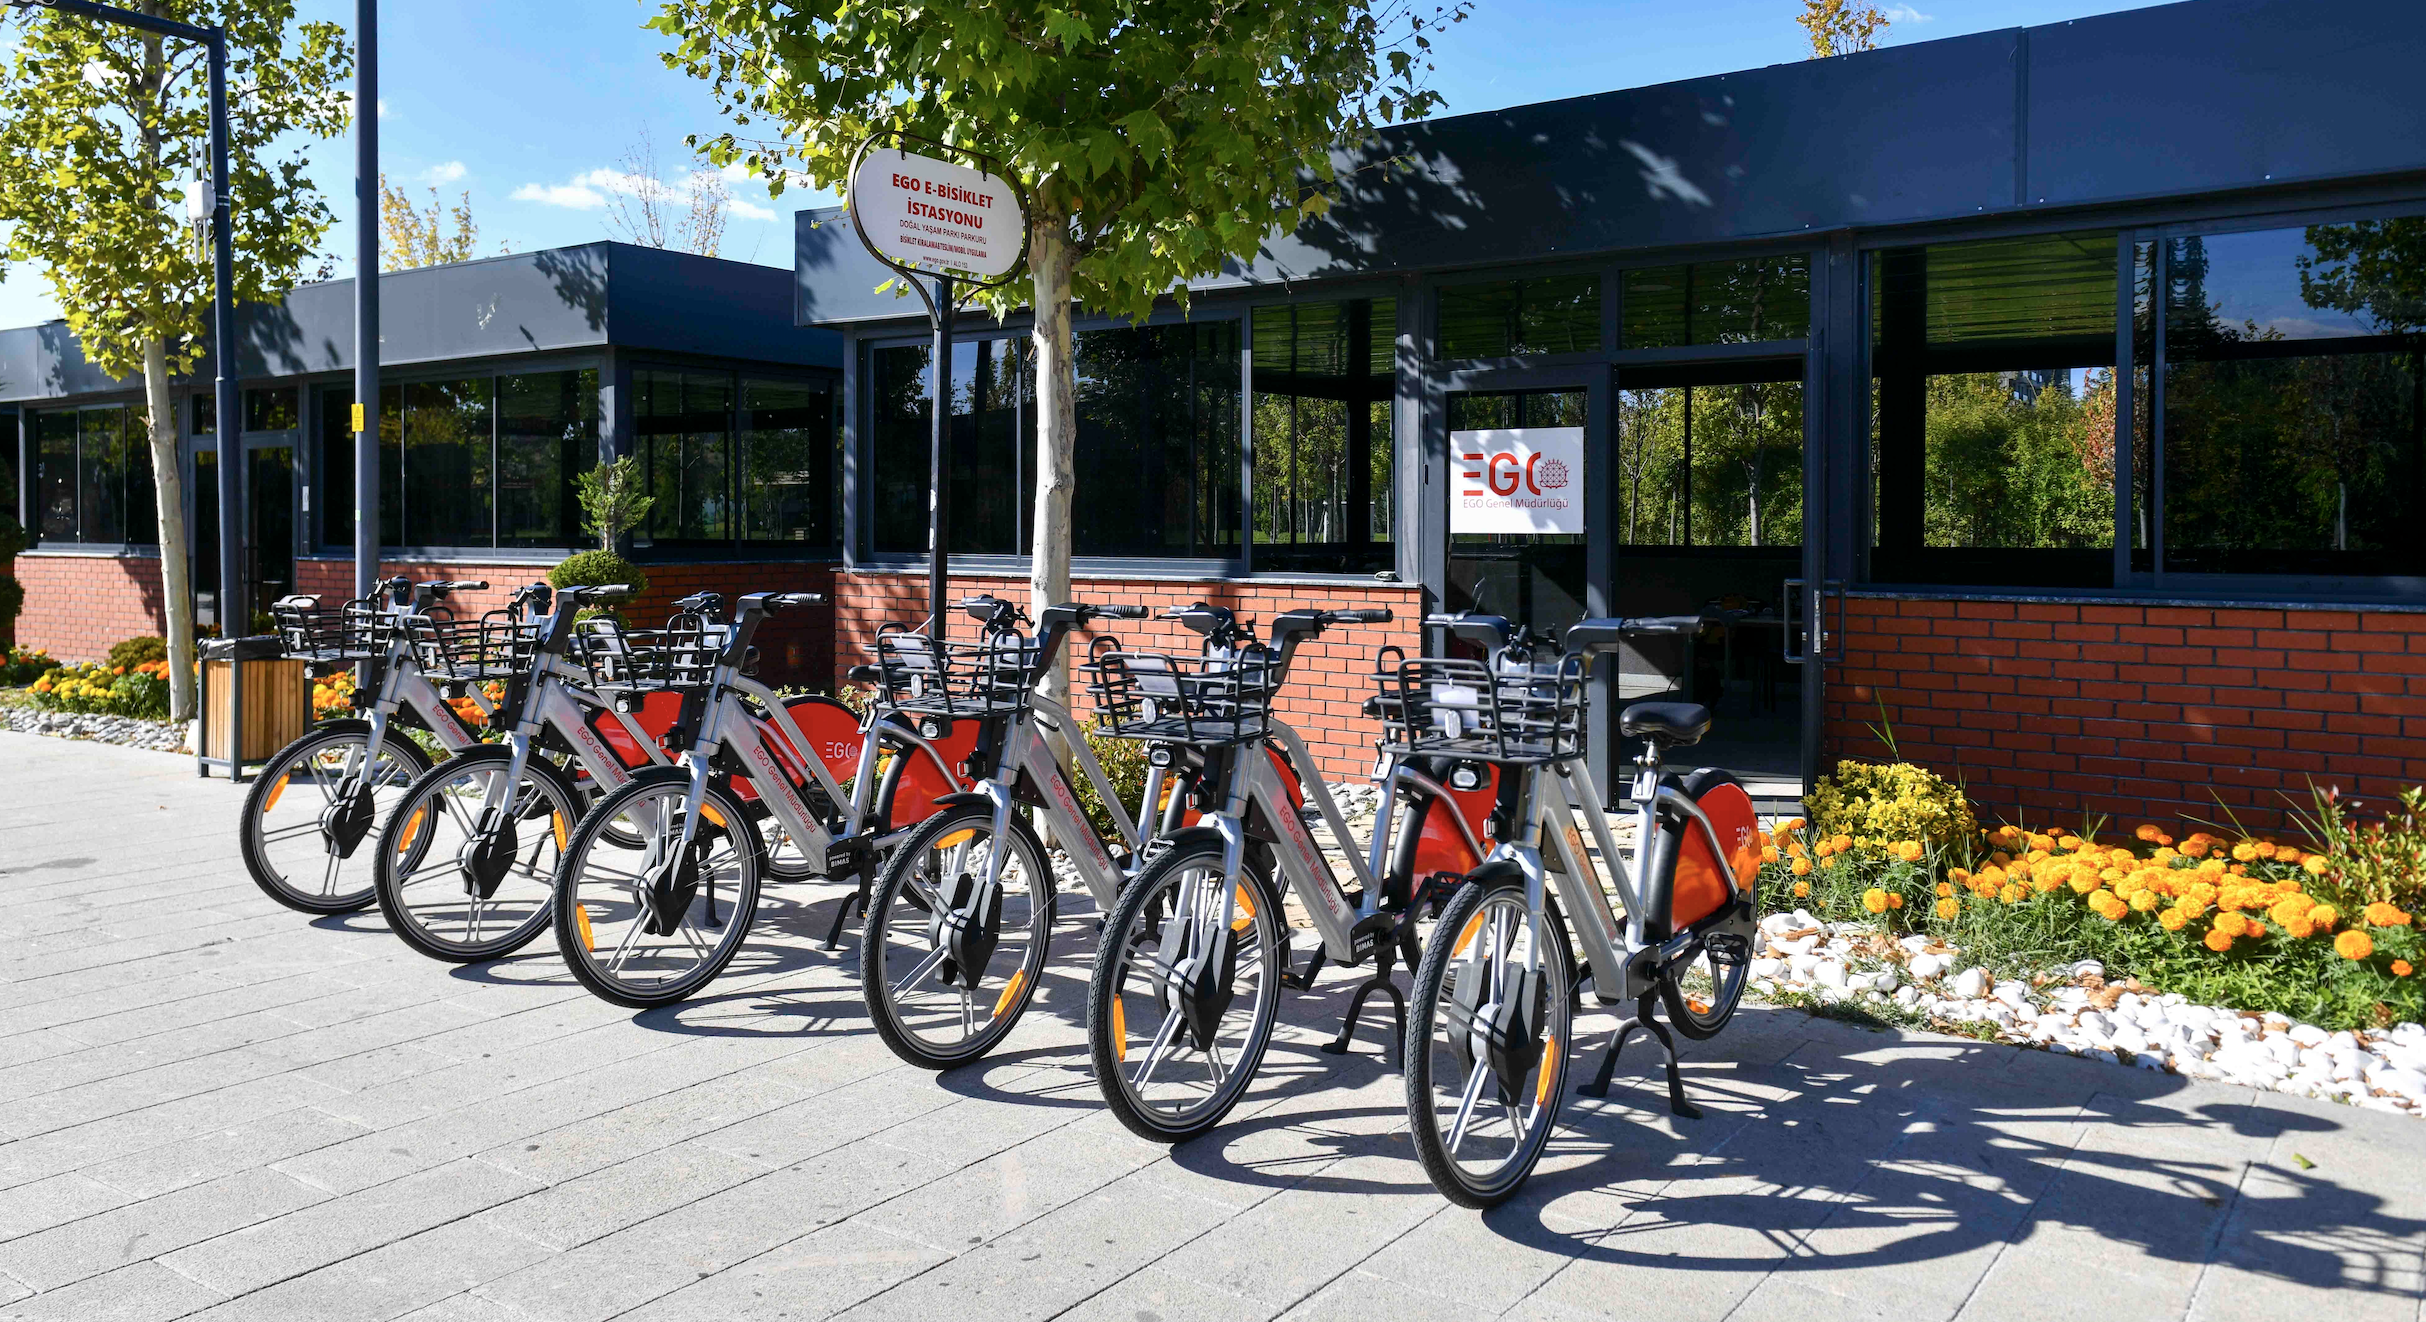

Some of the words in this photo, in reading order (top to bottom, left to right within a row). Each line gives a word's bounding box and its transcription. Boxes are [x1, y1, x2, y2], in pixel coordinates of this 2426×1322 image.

[892, 173, 921, 192] EGO
[925, 181, 993, 208] E-BİSİKLET
[907, 197, 983, 229] İSTASYONU
[899, 219, 921, 231] DOĞAL
[922, 223, 942, 236] YAŞAM
[943, 228, 960, 239] PARKI
[961, 232, 987, 244] PARKURU
[900, 233, 916, 244] BİSİKLET
[967, 247, 987, 258] UYGULAMA
[1463, 499, 1484, 508] EGO
[1486, 498, 1513, 508] Genel
[1515, 498, 1568, 510] Müdürlüğü
[432, 704, 449, 722] EGO
[447, 721, 468, 745] Genel
[577, 726, 594, 746] EGO
[593, 745, 614, 771] Genel
[753, 745, 769, 767] EGO
[768, 765, 788, 793] Genel
[785, 789, 817, 833] Müdürlüğü
[1051, 774, 1065, 797] EGO
[1063, 796, 1082, 826] Genel
[1080, 823, 1109, 870] Müdürlüğü
[1567, 827, 1580, 855] EGO
[1279, 805, 1295, 832] EGO
[1293, 830, 1313, 865] Genel
[1309, 860, 1340, 915] Müdürlüğü
